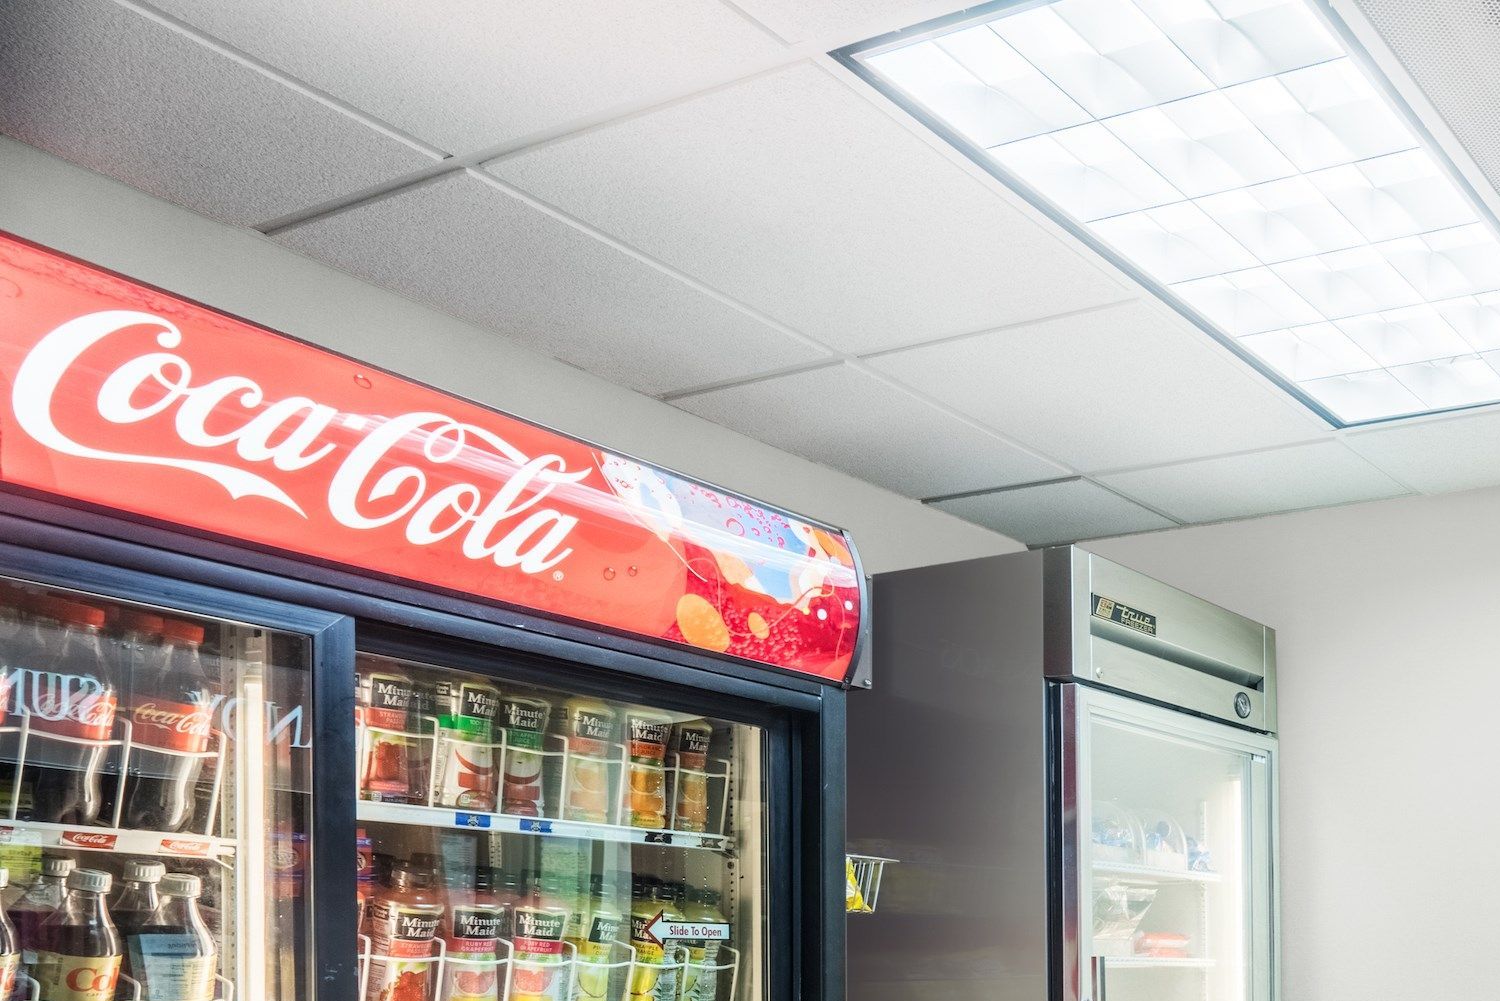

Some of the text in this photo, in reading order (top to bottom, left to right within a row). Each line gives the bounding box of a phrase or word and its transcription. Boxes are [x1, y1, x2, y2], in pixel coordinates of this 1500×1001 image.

[12, 309, 593, 577] Coca-Cola
[1120, 616, 1154, 634] FREEZER
[504, 704, 545, 720] Minute
[509, 715, 538, 728] Maid
[635, 729, 663, 742] Maid
[460, 914, 501, 926] Minute
[519, 914, 561, 928] Minute
[407, 926, 434, 938] Maid
[466, 925, 496, 937] Maid
[523, 924, 553, 937] Maid
[669, 926, 722, 938] Slide To Open
